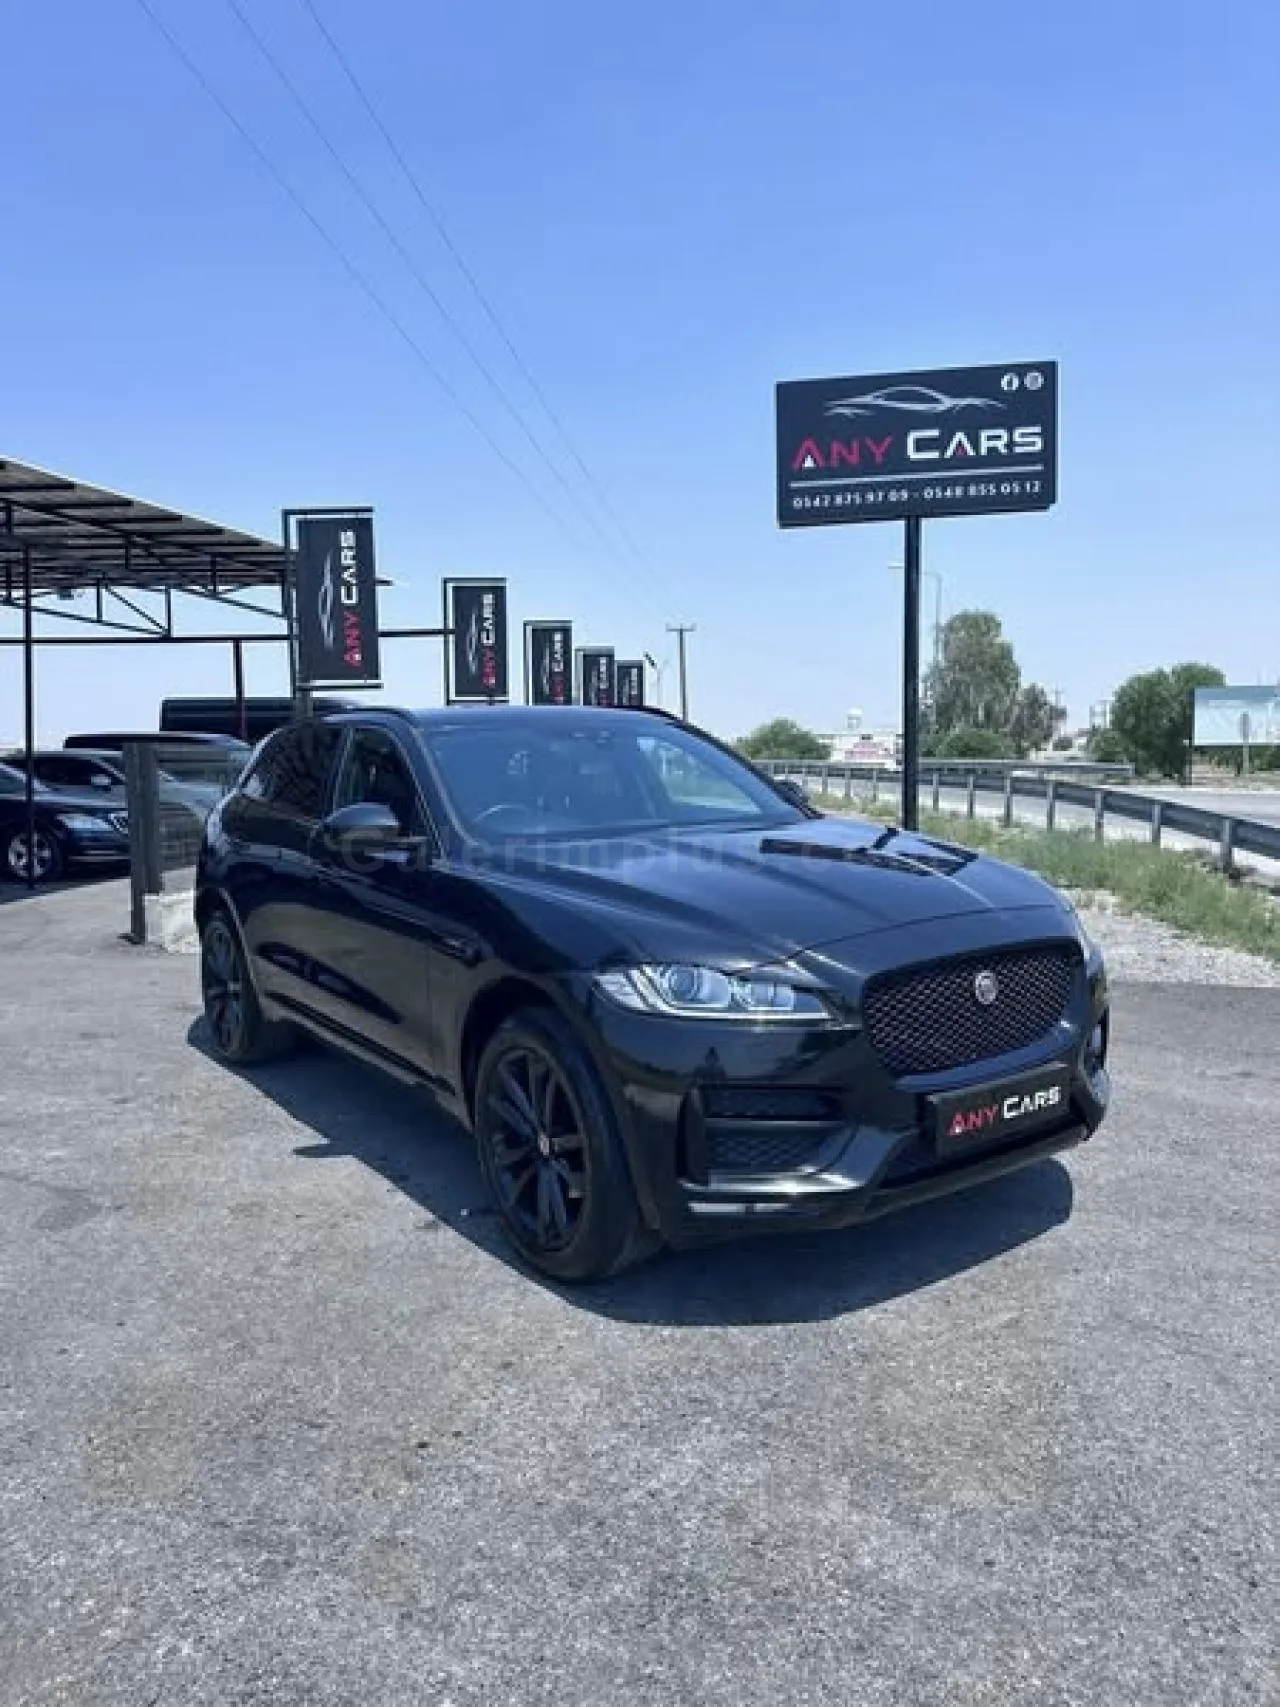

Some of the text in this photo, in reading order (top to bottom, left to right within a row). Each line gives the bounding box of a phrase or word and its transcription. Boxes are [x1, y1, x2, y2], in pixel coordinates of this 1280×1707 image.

[791, 426, 1042, 470] ANY CARS
[340, 529, 362, 670] ANY CARS
[481, 593, 496, 687] ANY CARS
[947, 1086, 1062, 1137] ANY CARS
